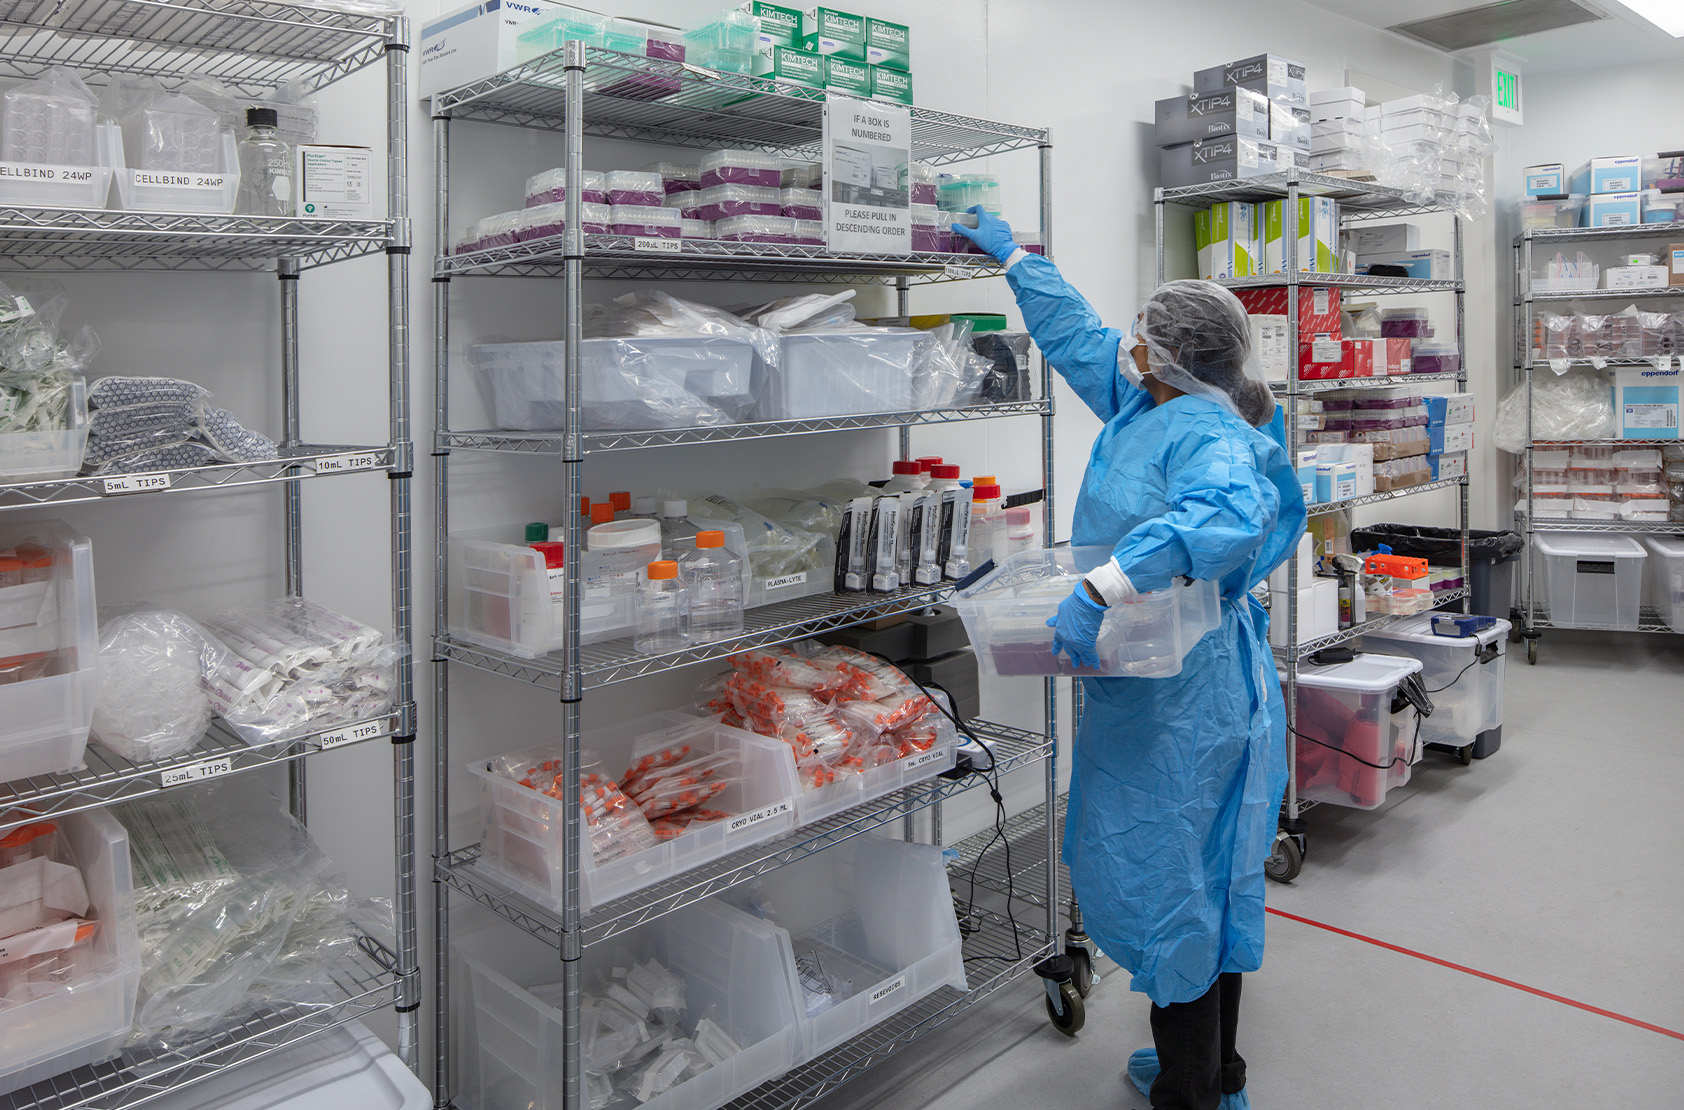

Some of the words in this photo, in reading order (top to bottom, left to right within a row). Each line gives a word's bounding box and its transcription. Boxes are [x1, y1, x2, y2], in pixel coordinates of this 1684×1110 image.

[506, 1, 532, 13] VWR
[760, 8, 798, 24] KIMTECH
[824, 14, 860, 28] KIMTECH
[872, 24, 905, 38] KIMTECH
[781, 53, 818, 67] KIMTECH
[831, 62, 865, 76] KIMTECH
[877, 71, 908, 85] KIMTECH
[1497, 71, 1515, 109] EXIT
[853, 114, 861, 123] IF
[861, 116, 867, 125] A
[868, 117, 882, 127] BOX
[883, 120, 890, 128] IS
[1208, 122, 1231, 133] Biotix
[851, 128, 892, 142] NUMBERED
[0, 167, 55, 179] ELLBIND
[63, 171, 92, 181] 24WP
[135, 174, 190, 186] CELLBIND
[197, 178, 223, 187] 24WP
[1210, 169, 1232, 181] Biotix
[845, 210, 870, 220] PLEASE
[871, 211, 888, 221] PULL
[889, 213, 897, 222] IN
[836, 223, 880, 235] DESCENDING
[882, 226, 906, 236] ORDER
[662, 242, 679, 250] TIPS
[1641, 369, 1679, 377] eppendorf
[318, 460, 342, 470] 10mL
[348, 457, 372, 467] TIPS
[107, 481, 129, 490] 5mL
[136, 477, 166, 488] TIPS
[767, 575, 802, 588] PLASMA-LYTE
[323, 733, 347, 746] 50mL
[353, 725, 377, 738] TIPS
[919, 755, 931, 764] CRYO
[932, 751, 944, 759] VIAL
[165, 771, 193, 784] 25mL
[200, 763, 228, 776] TIPS
[731, 818, 747, 830] CRYO
[749, 812, 764, 823] VIAL
[766, 806, 778, 817] 2.5
[780, 803, 788, 812] ML
[873, 980, 901, 1000] RESEVOIRS
